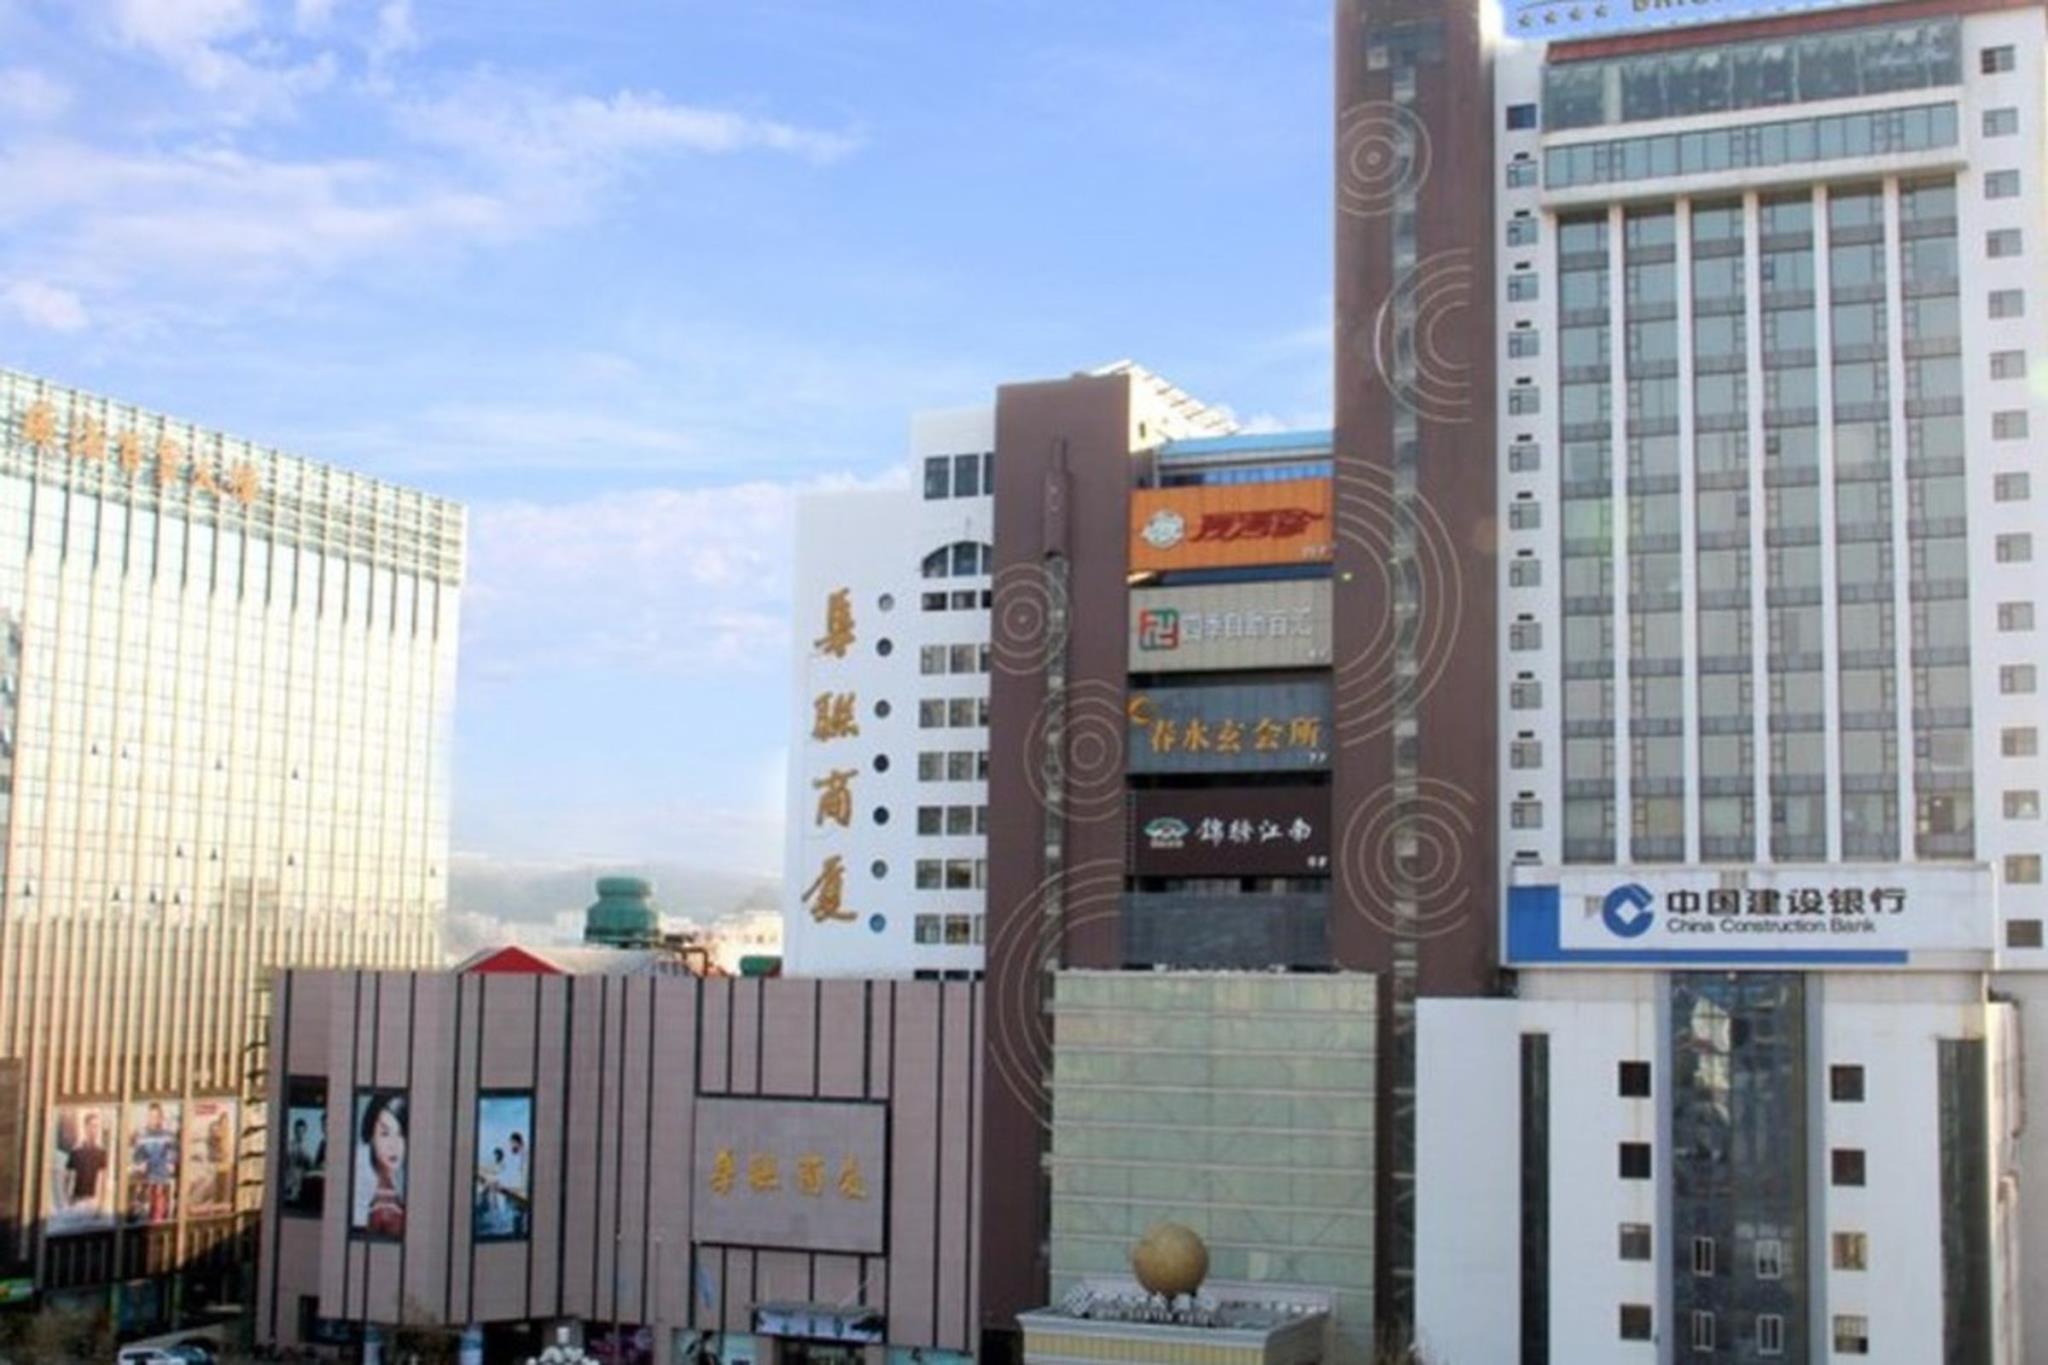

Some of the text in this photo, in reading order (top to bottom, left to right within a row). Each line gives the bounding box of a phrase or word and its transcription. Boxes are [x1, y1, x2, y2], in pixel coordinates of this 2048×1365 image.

[1666, 887, 1906, 916] 中国建设银行
[1666, 917, 1876, 934] China Construction Bank
